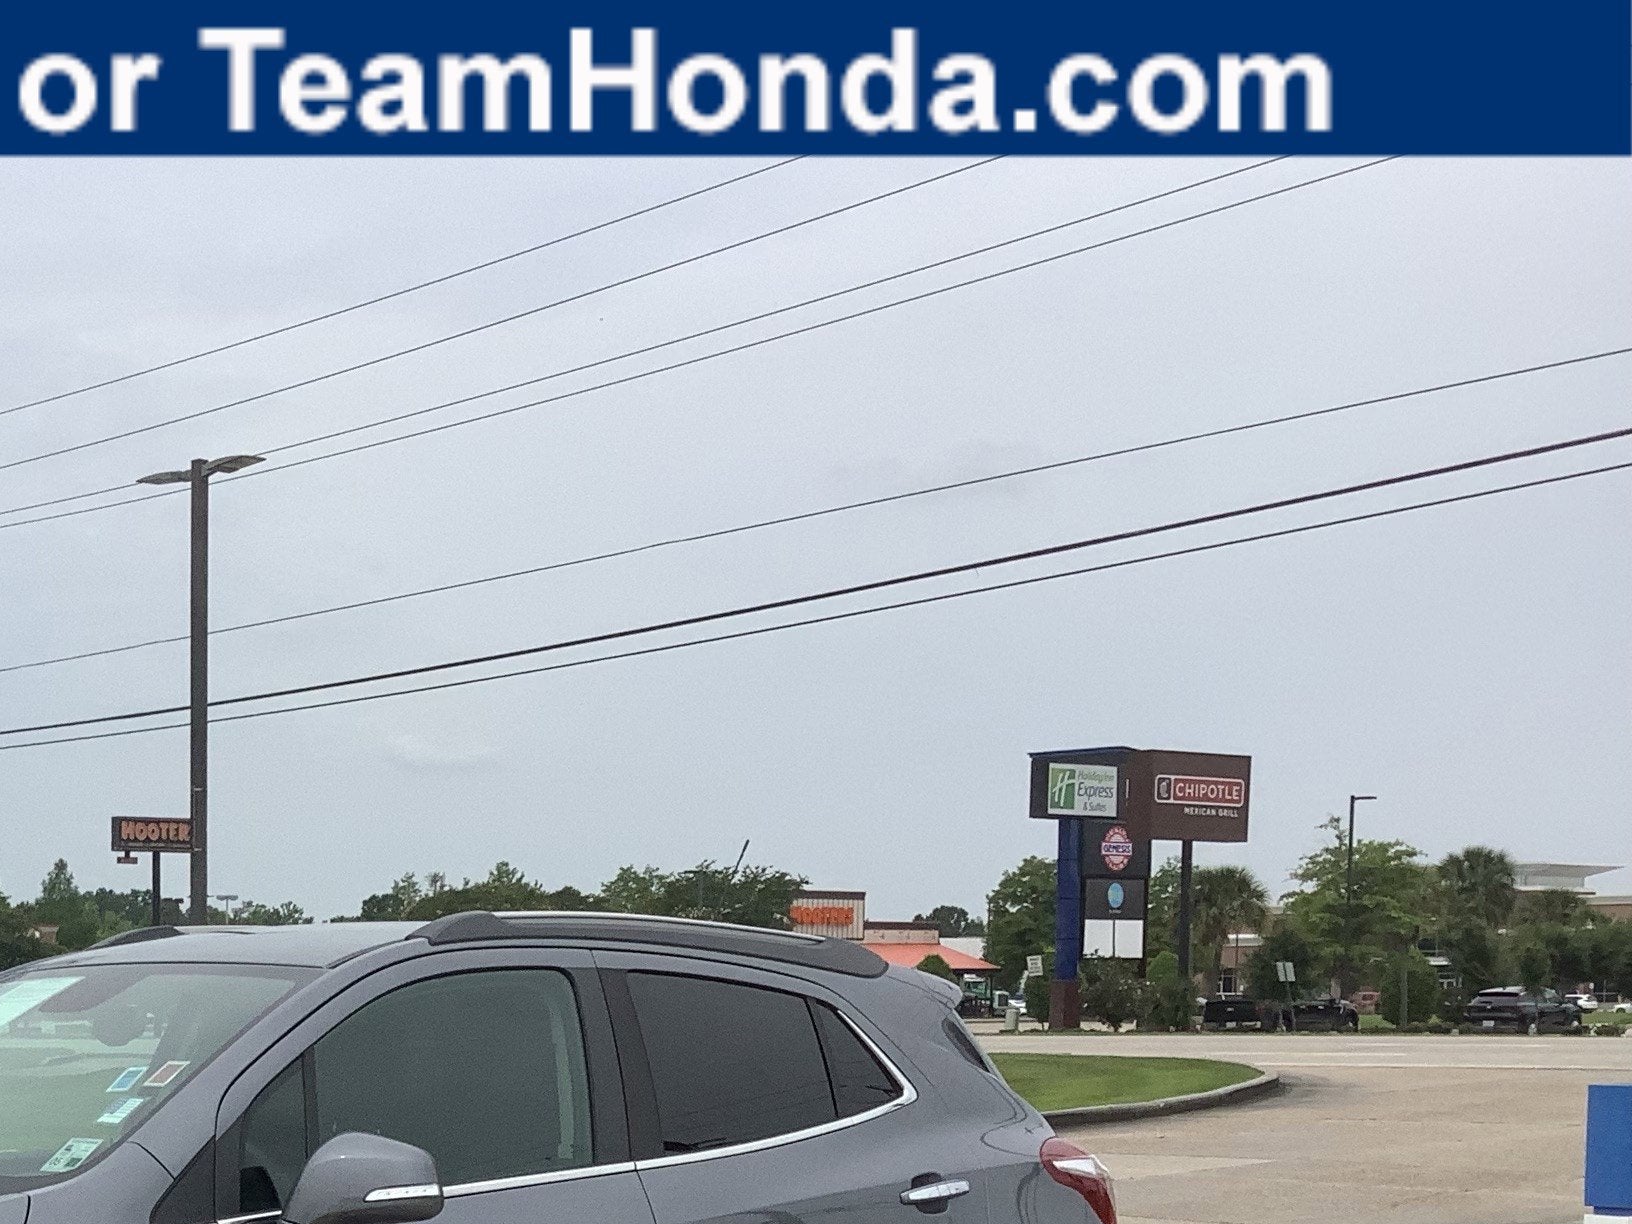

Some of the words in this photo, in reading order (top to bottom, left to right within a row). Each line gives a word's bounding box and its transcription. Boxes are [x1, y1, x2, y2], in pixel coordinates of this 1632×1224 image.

[1077, 781, 1114, 801] Express
[1175, 782, 1241, 800] CHIPOTLE
[1183, 806, 1217, 817] MEXICAN
[1218, 808, 1239, 818] GRILL
